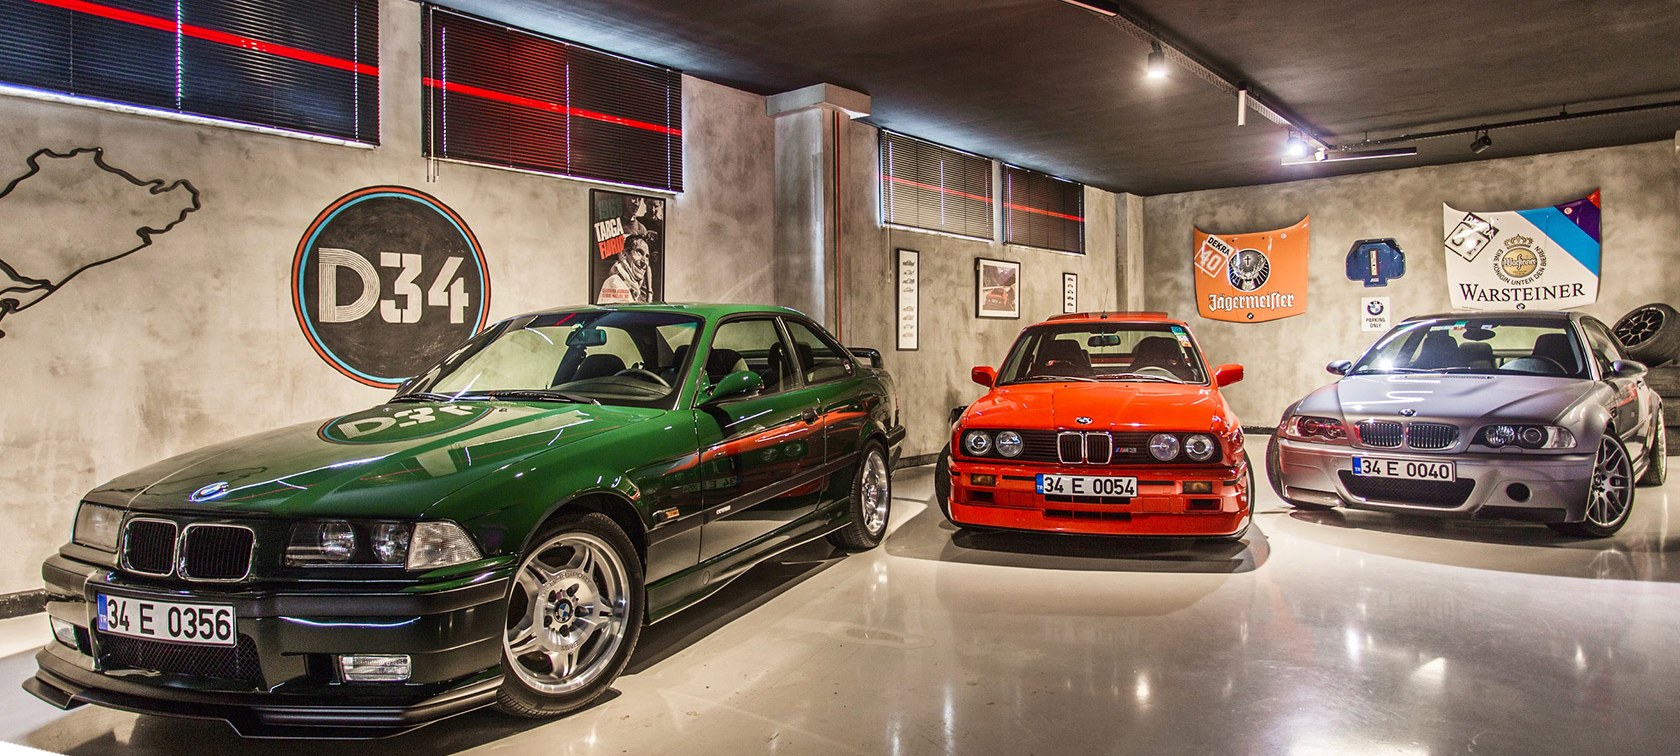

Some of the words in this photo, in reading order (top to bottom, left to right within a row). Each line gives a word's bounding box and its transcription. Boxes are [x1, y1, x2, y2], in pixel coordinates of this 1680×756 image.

[594, 217, 624, 243] TARGA
[1207, 236, 1231, 256] DEKRA
[1493, 248, 1504, 261] EINE
[1534, 245, 1547, 267] BIEREN
[1200, 250, 1222, 271] 40
[1510, 277, 1535, 286] UNTER
[1533, 267, 1545, 280] DEN
[318, 247, 469, 324] D34
[1459, 283, 1586, 302] WARSTEINER
[1208, 292, 1295, 312] Jägermeister
[1362, 459, 1381, 475] 34
[1387, 461, 1399, 476] E
[1406, 462, 1450, 479] 0040
[1044, 477, 1064, 493] 34
[1072, 478, 1085, 494] E
[1093, 478, 1135, 495] 0054
[108, 599, 130, 631] 34
[140, 603, 155, 635] E
[168, 606, 231, 641] 0356
